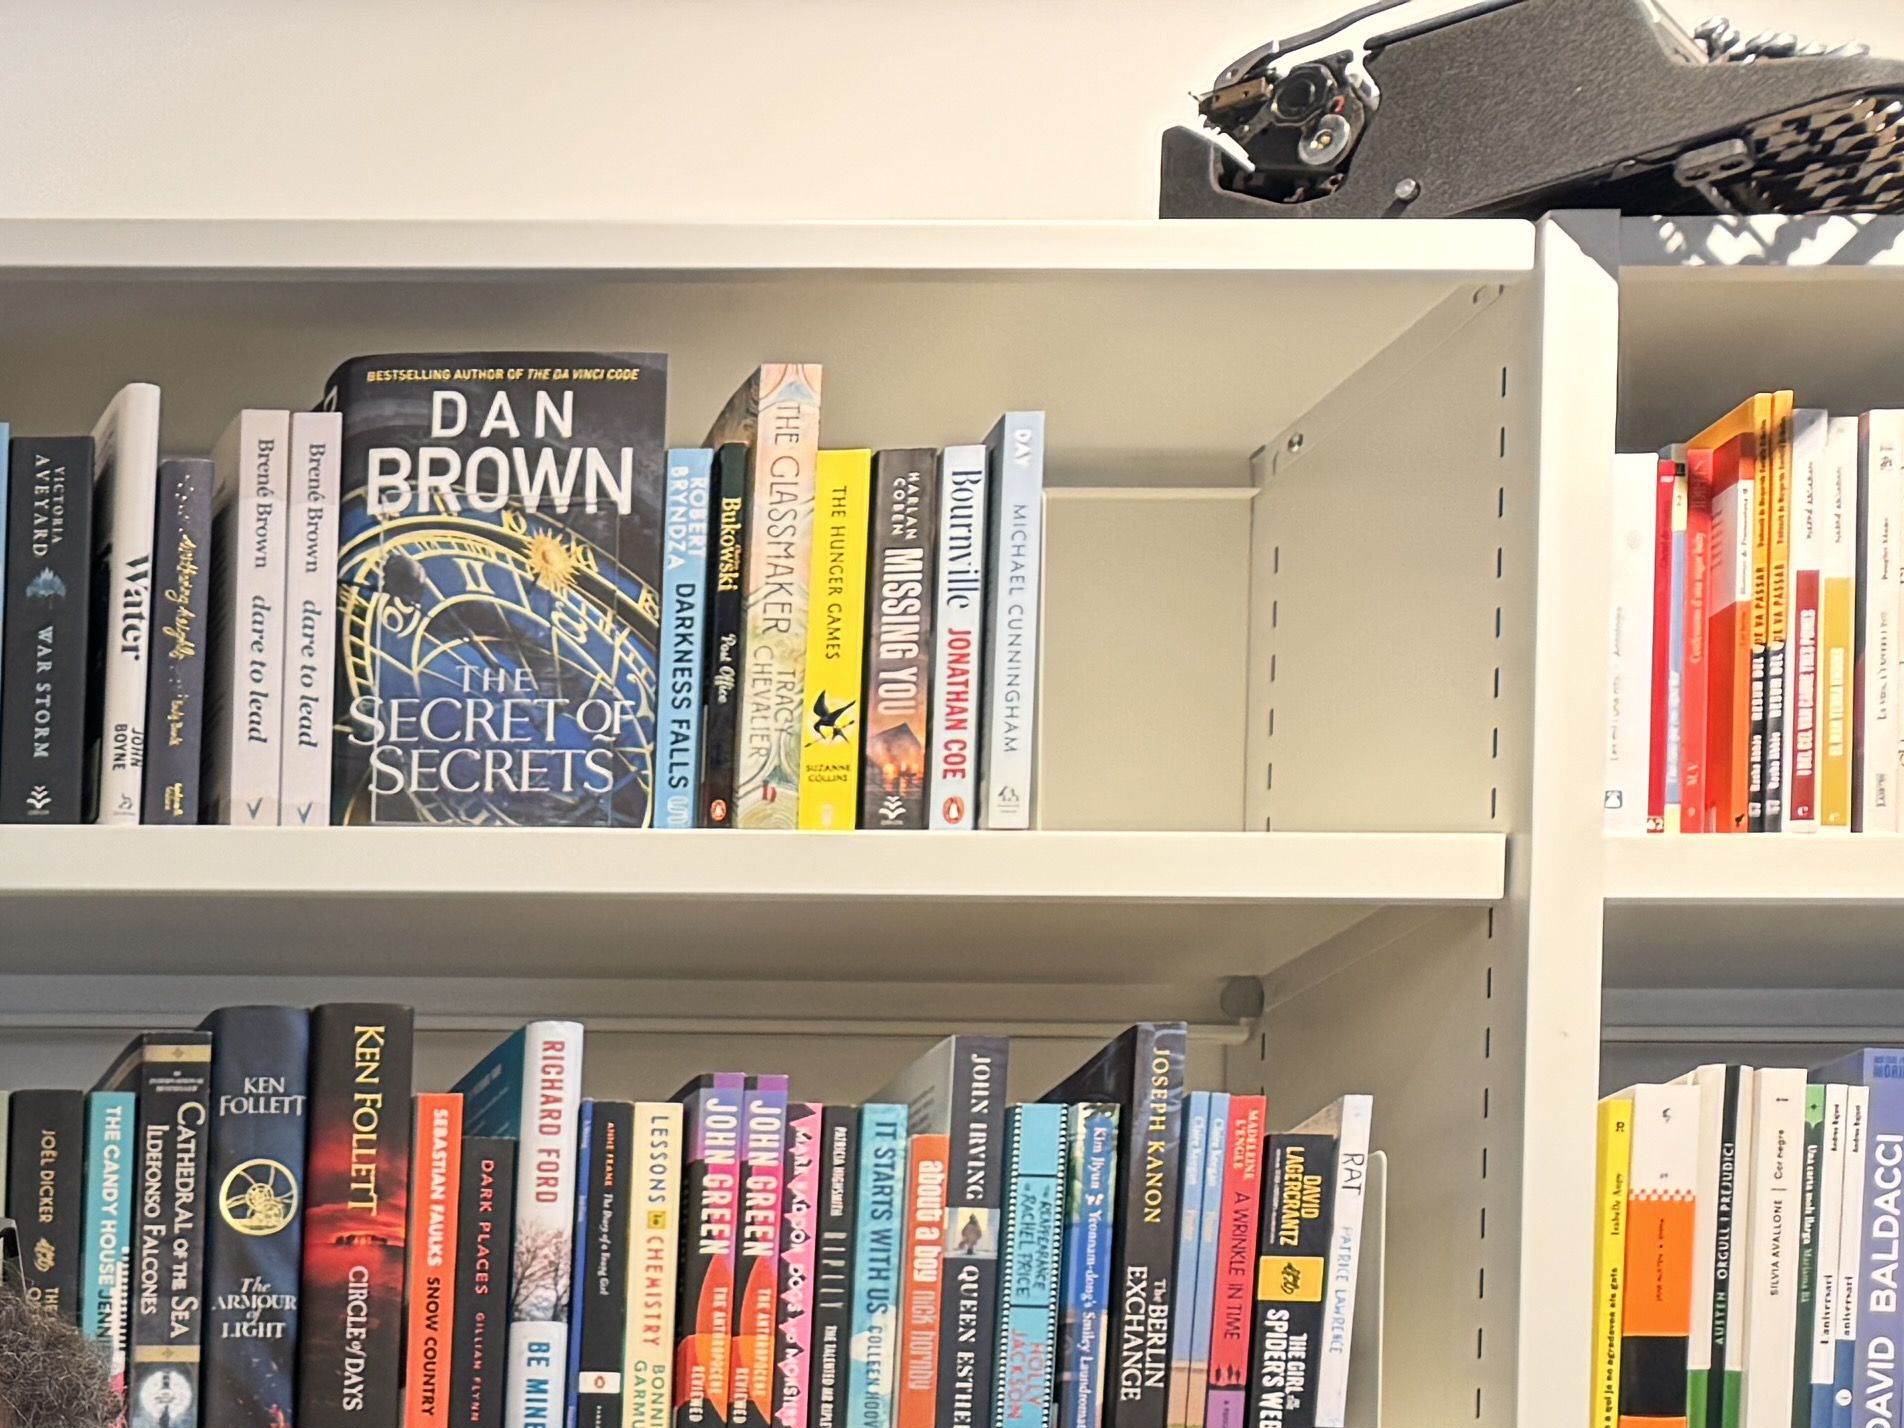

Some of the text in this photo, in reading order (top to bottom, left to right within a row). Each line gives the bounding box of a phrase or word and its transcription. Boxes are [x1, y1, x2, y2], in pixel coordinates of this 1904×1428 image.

[367, 369, 640, 382] BESTSELLING AUTHOR OF THE DA VINCI CODE
[431, 390, 573, 439] DAN
[32, 454, 49, 557] AVEYARD
[254, 438, 275, 569] Brené Brown
[367, 446, 633, 516] BROWN
[717, 497, 742, 592] Bukowski
[946, 469, 982, 610] Bournville
[121, 554, 149, 660] Water
[248, 595, 267, 743] dare to lead
[882, 546, 922, 716] MISSING YOU
[32, 626, 54, 758] WAR STORM
[348, 696, 636, 746] SECRET OF
[457, 665, 532, 692] THE
[668, 583, 696, 789] DARKNESS FALLS
[942, 626, 971, 781] JONATHAN COE
[370, 748, 614, 795] SECRETS
[349, 1024, 384, 1218] KEN FOLLETT
[534, 1039, 567, 1205] RICHARD FORD
[698, 1098, 739, 1255] JOHN GREEN
[1144, 1045, 1171, 1225] JOSEPH KANON
[866, 1122, 897, 1315] IT STARTS WITH US
[1869, 1134, 1903, 1313] BALDACCI
[343, 1265, 371, 1412] CIRCLE of DAYS
[527, 1340, 552, 1376] BE
